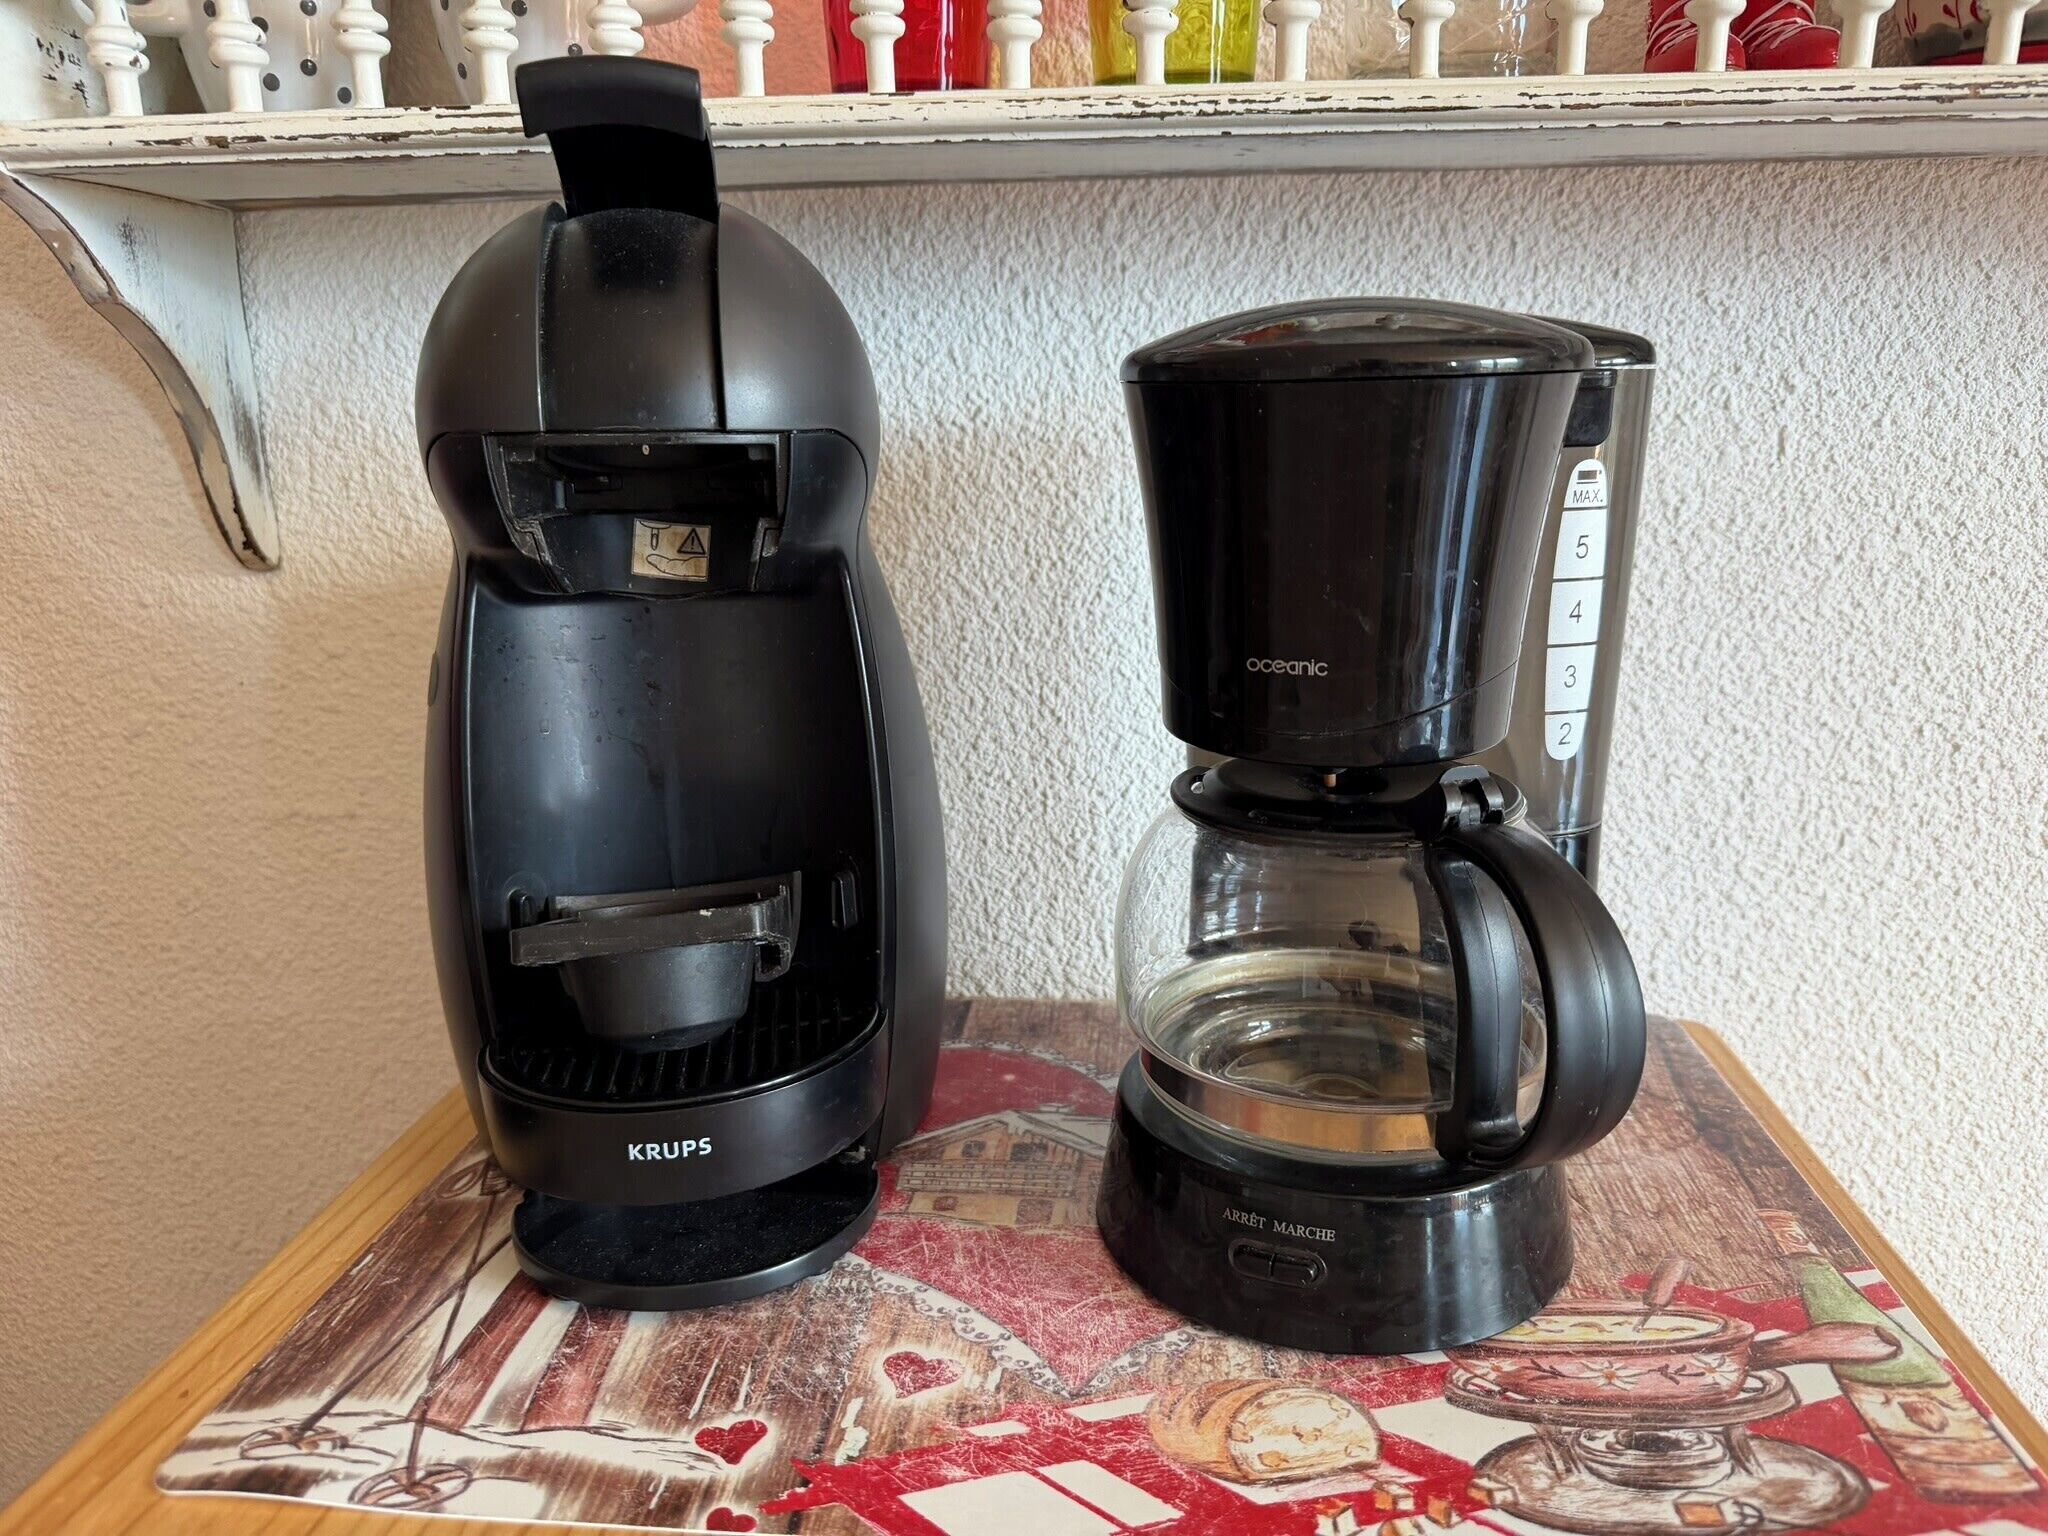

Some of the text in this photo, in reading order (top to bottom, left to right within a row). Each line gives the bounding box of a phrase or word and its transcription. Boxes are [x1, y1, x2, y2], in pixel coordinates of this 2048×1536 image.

[1573, 489, 1603, 503] MAX.
[1576, 535, 1589, 559] 5
[1569, 600, 1582, 624] 4
[1246, 658, 1328, 676] oceanic
[1564, 664, 1576, 688] 3
[1558, 722, 1572, 745] 2
[628, 1137, 712, 1160] KRUPS
[1223, 1207, 1336, 1242] ARRÊT MARCHE
